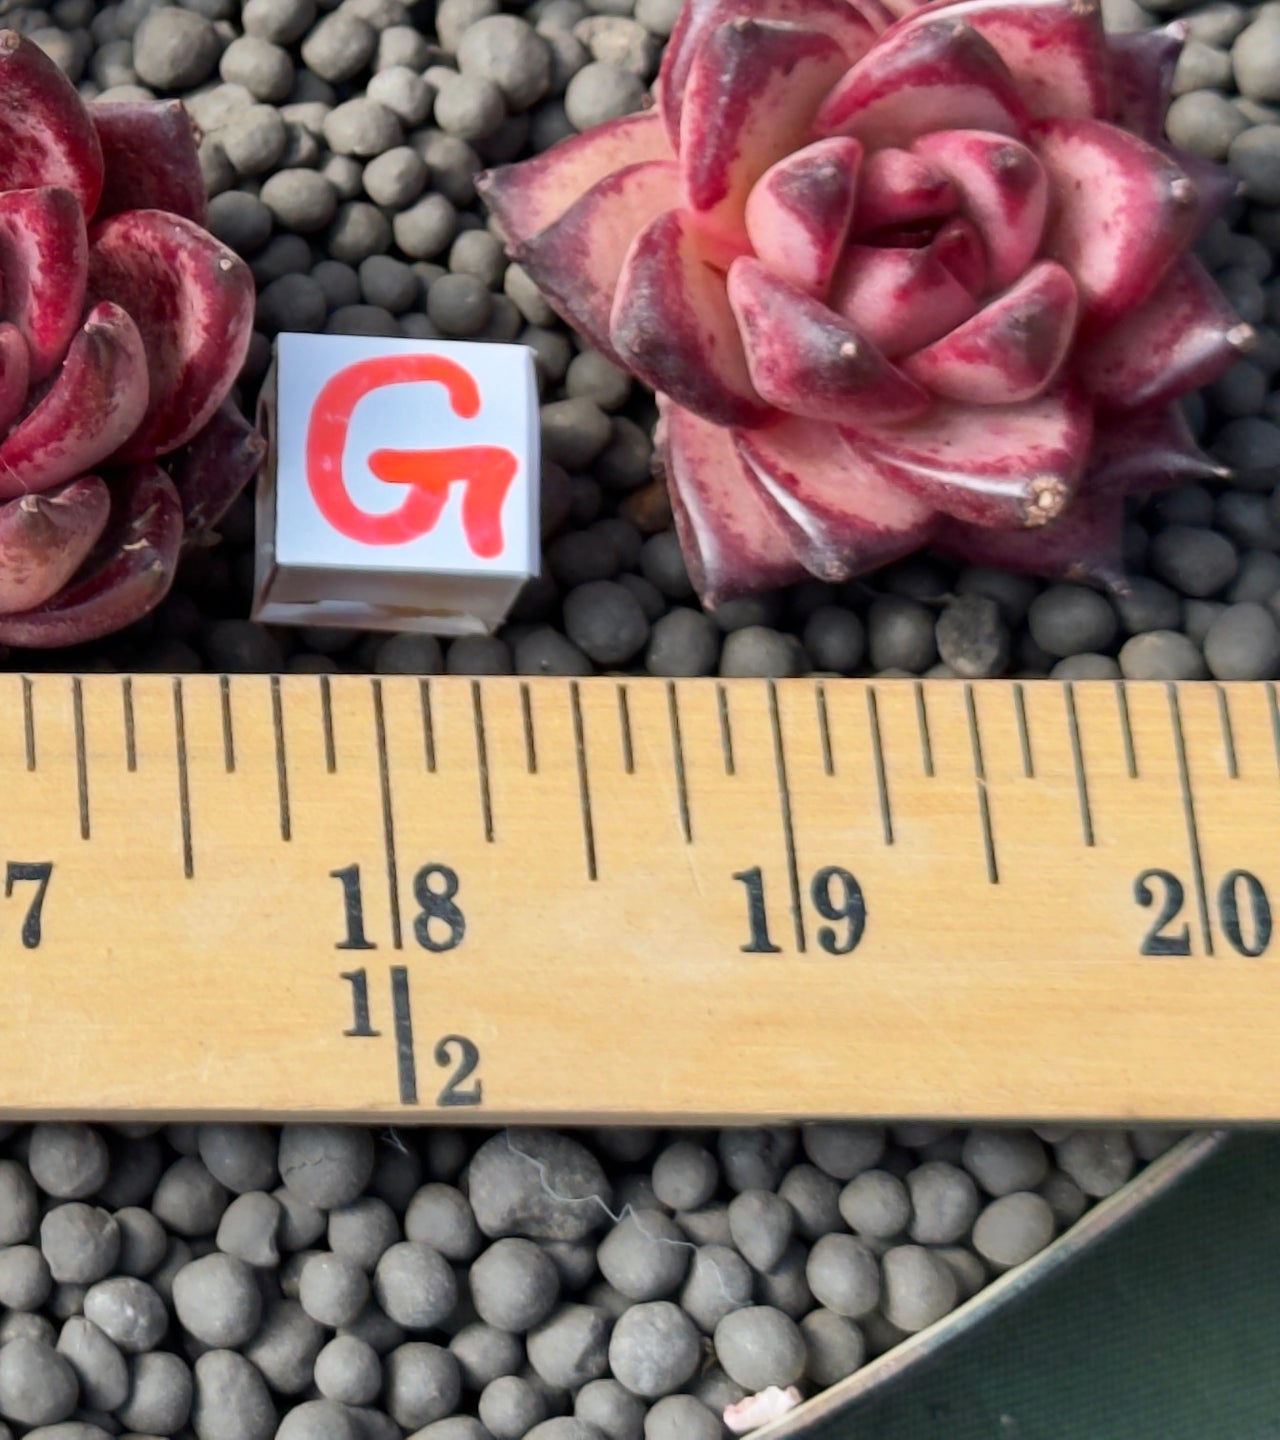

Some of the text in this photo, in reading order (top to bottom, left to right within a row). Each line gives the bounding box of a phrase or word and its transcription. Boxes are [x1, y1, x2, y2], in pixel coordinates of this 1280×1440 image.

[306, 354, 519, 560] G
[329, 863, 467, 954] 18
[732, 865, 869, 956] 19
[1134, 868, 1275, 959] 20
